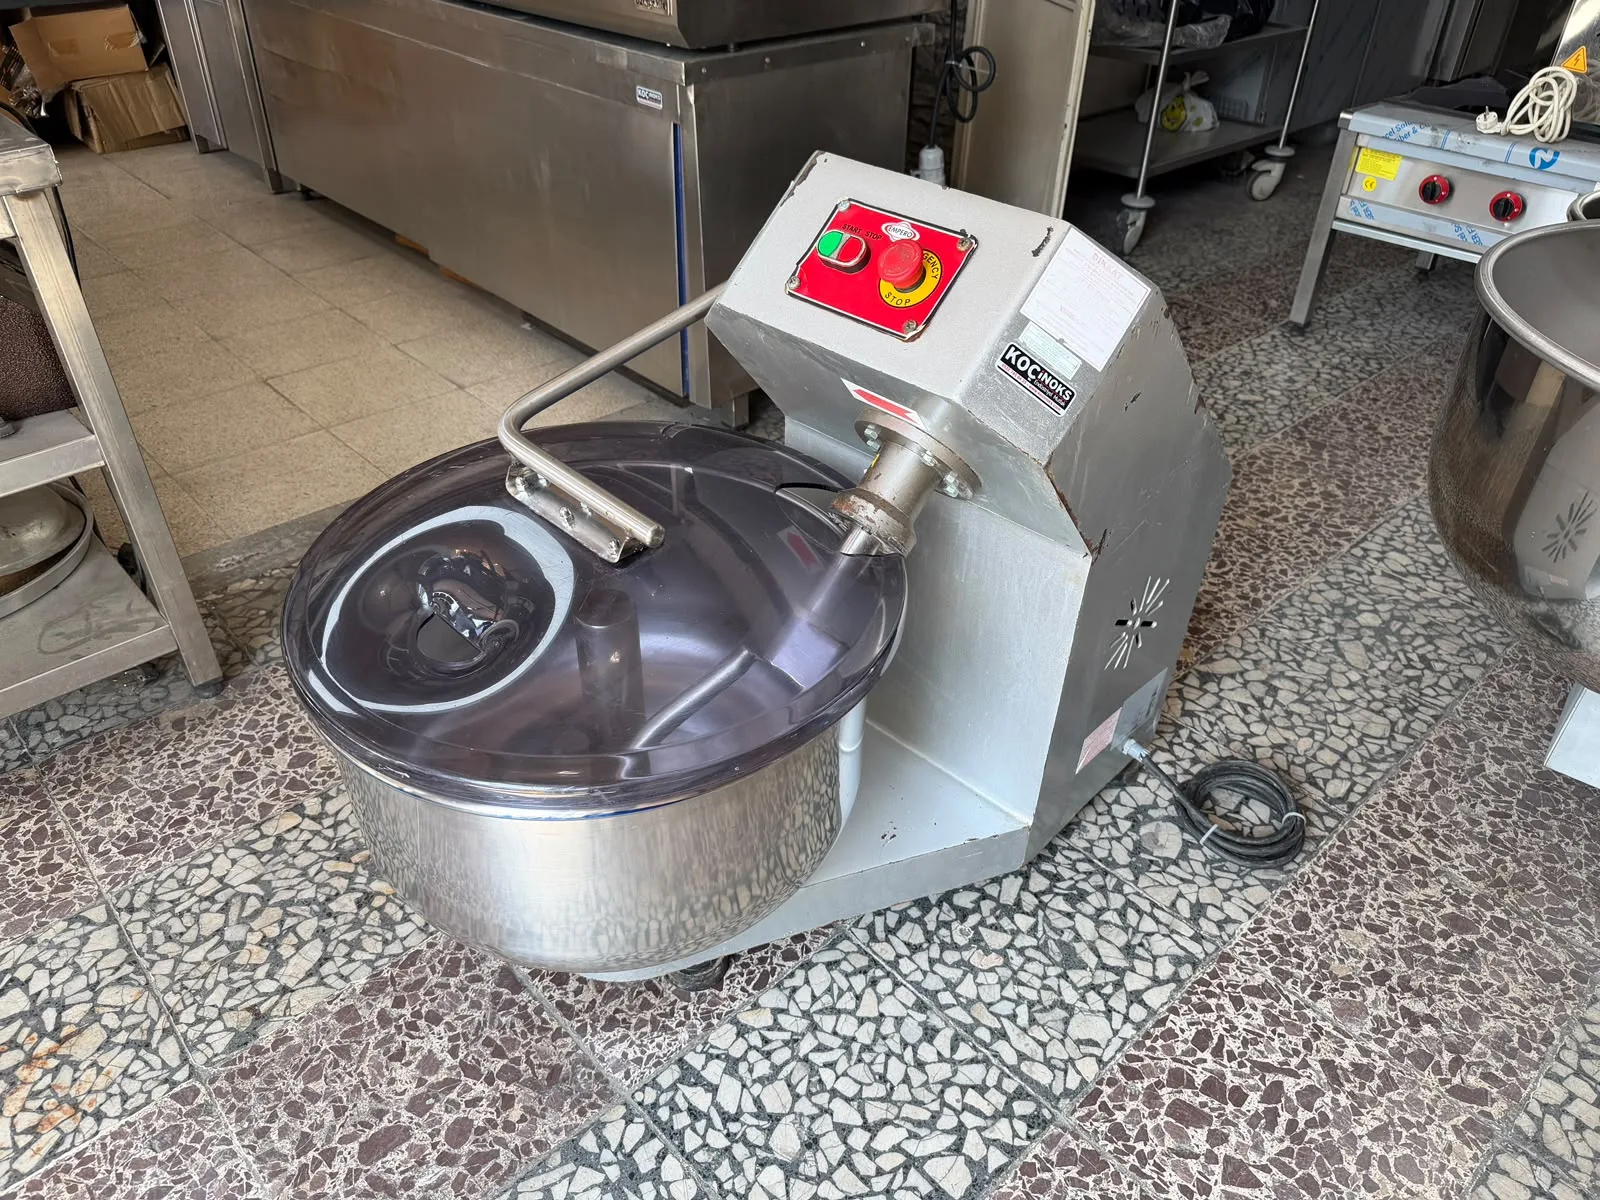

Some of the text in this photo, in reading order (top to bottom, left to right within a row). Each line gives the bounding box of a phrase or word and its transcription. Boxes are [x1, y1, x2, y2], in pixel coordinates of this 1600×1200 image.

[842, 223, 882, 241] START STOP
[888, 226, 913, 239] EMPERO
[884, 291, 911, 306] STOP
